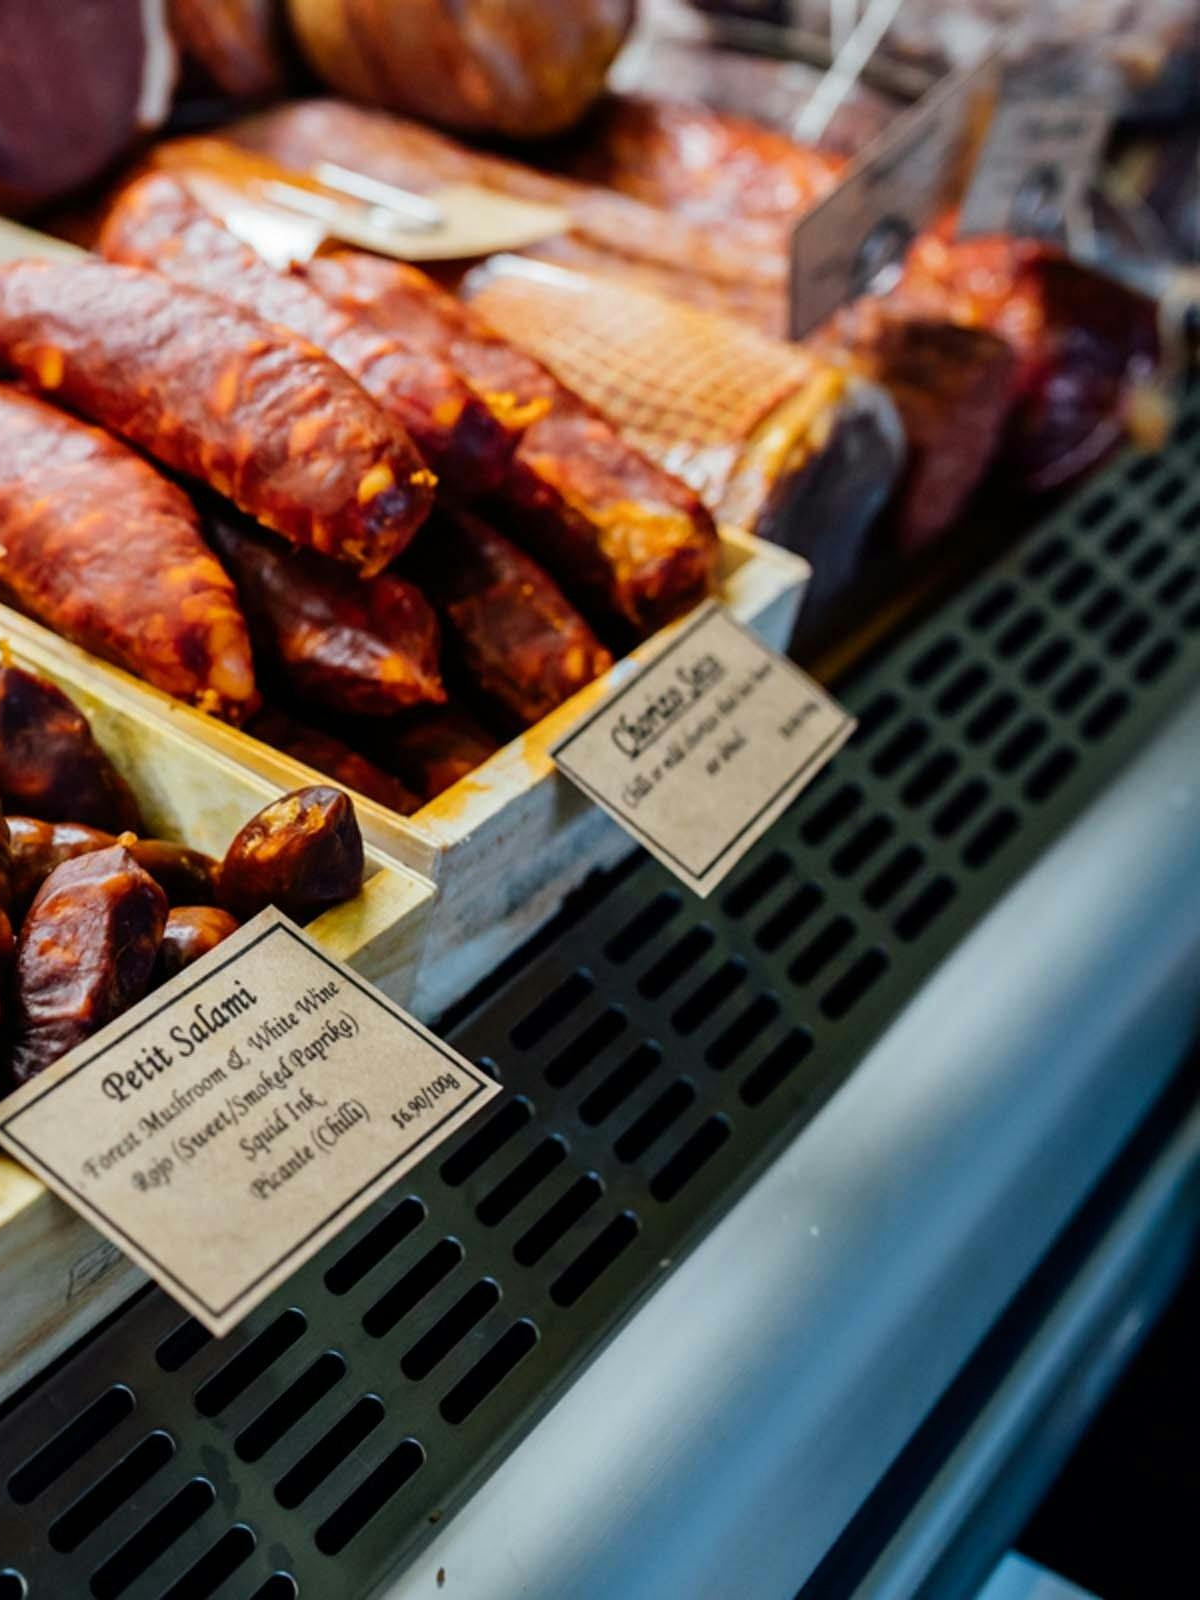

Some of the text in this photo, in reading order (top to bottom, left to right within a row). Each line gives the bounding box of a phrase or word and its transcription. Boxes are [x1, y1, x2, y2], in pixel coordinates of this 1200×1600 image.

[82, 981, 341, 1179] Forest Mushroom & White Wine
[101, 979, 257, 1102] Petit Salami
[131, 1010, 360, 1192] Rojo (Sweet/Smoked Paprika)
[239, 1086, 328, 1162] Squid Ink
[250, 1098, 372, 1199] Picante (Chilli)
